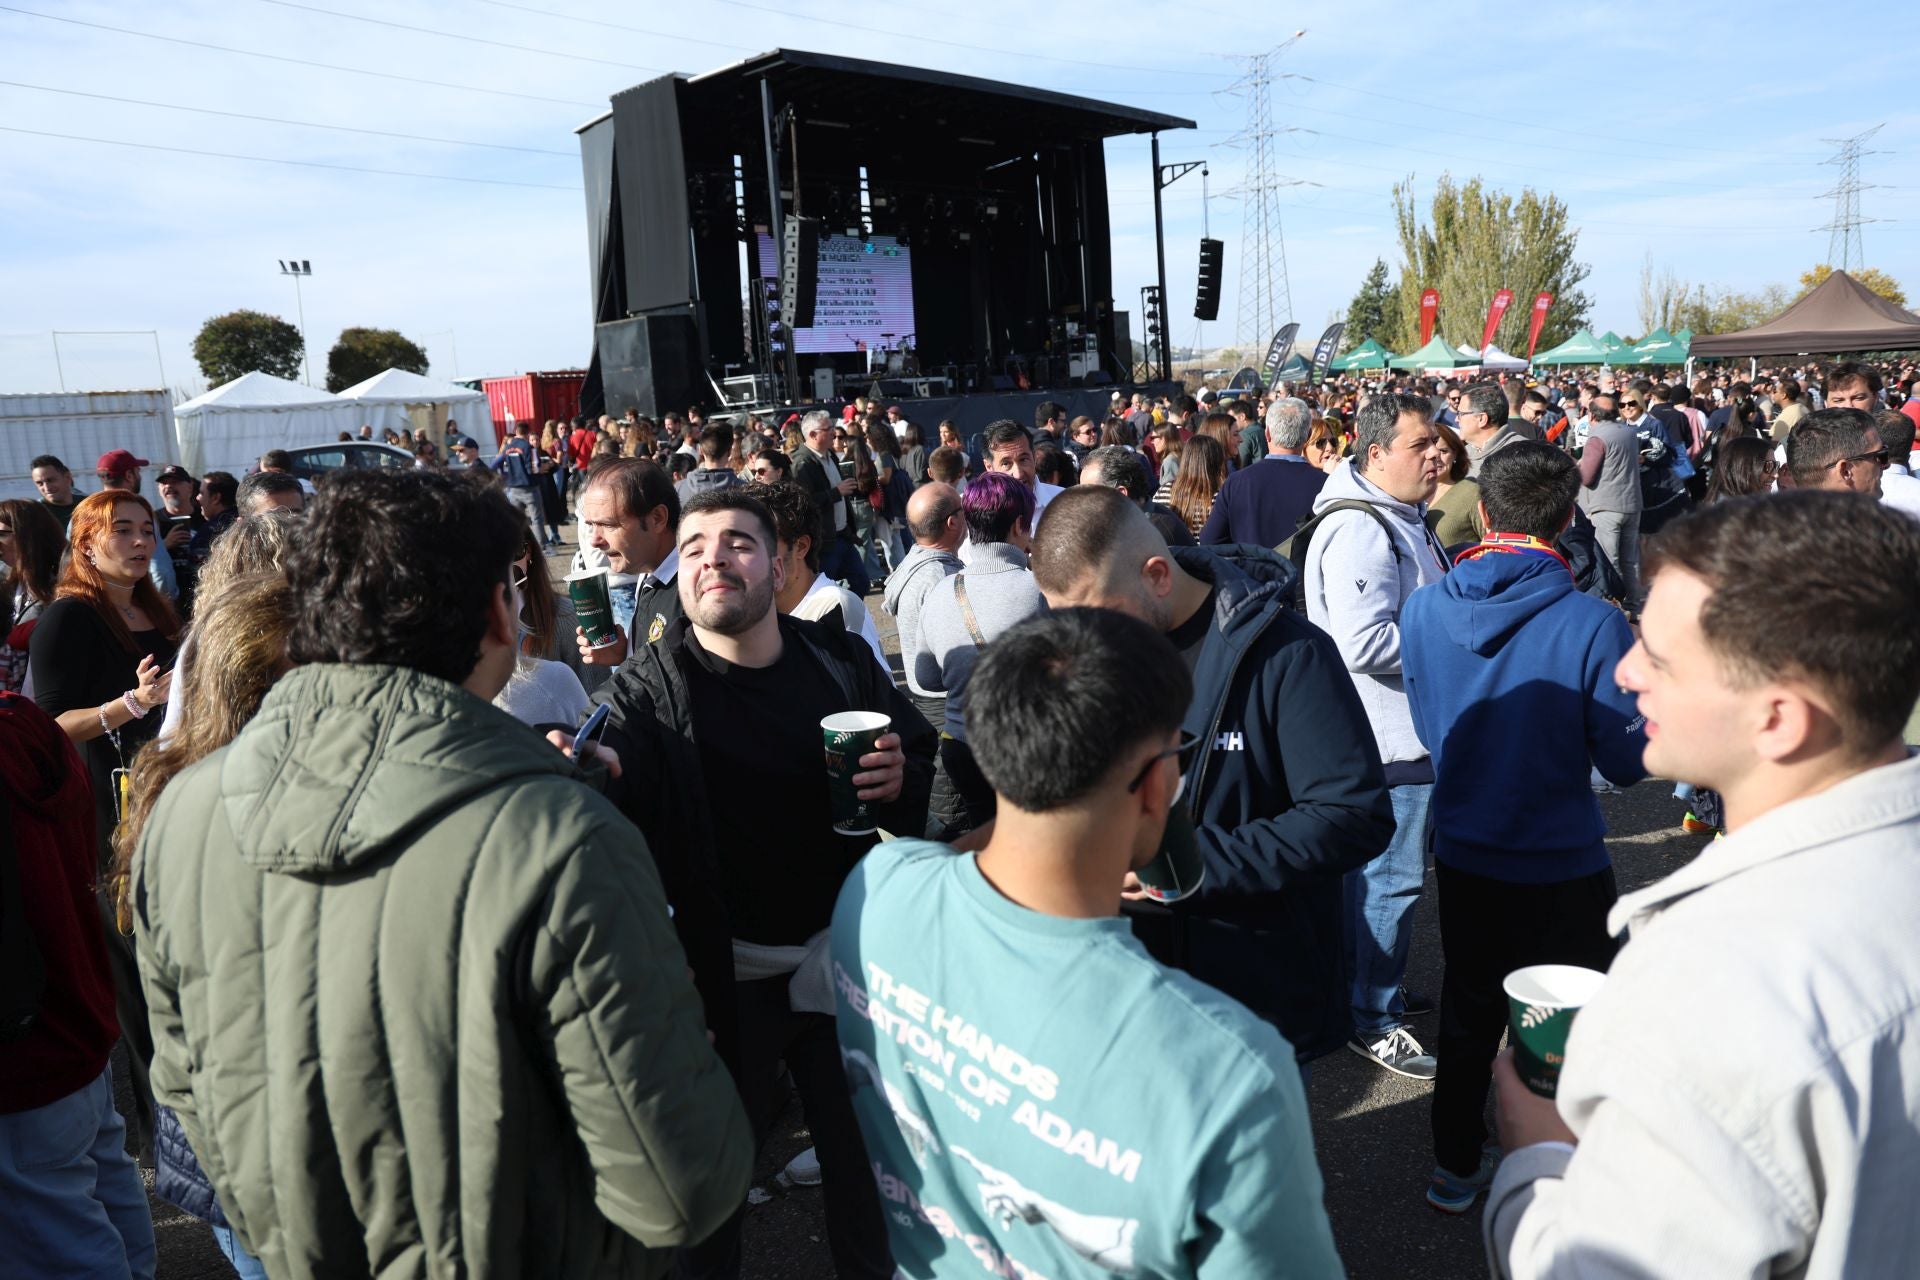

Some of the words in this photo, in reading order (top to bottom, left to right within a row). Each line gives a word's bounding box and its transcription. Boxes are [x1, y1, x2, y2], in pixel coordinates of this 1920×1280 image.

[1212, 731, 1245, 751] HH
[867, 961, 931, 1024] THE
[930, 1008, 1060, 1101] HANDS
[1545, 1052, 1566, 1064] De
[959, 1063, 1012, 1108] OF
[1012, 1100, 1142, 1183] ADAM
